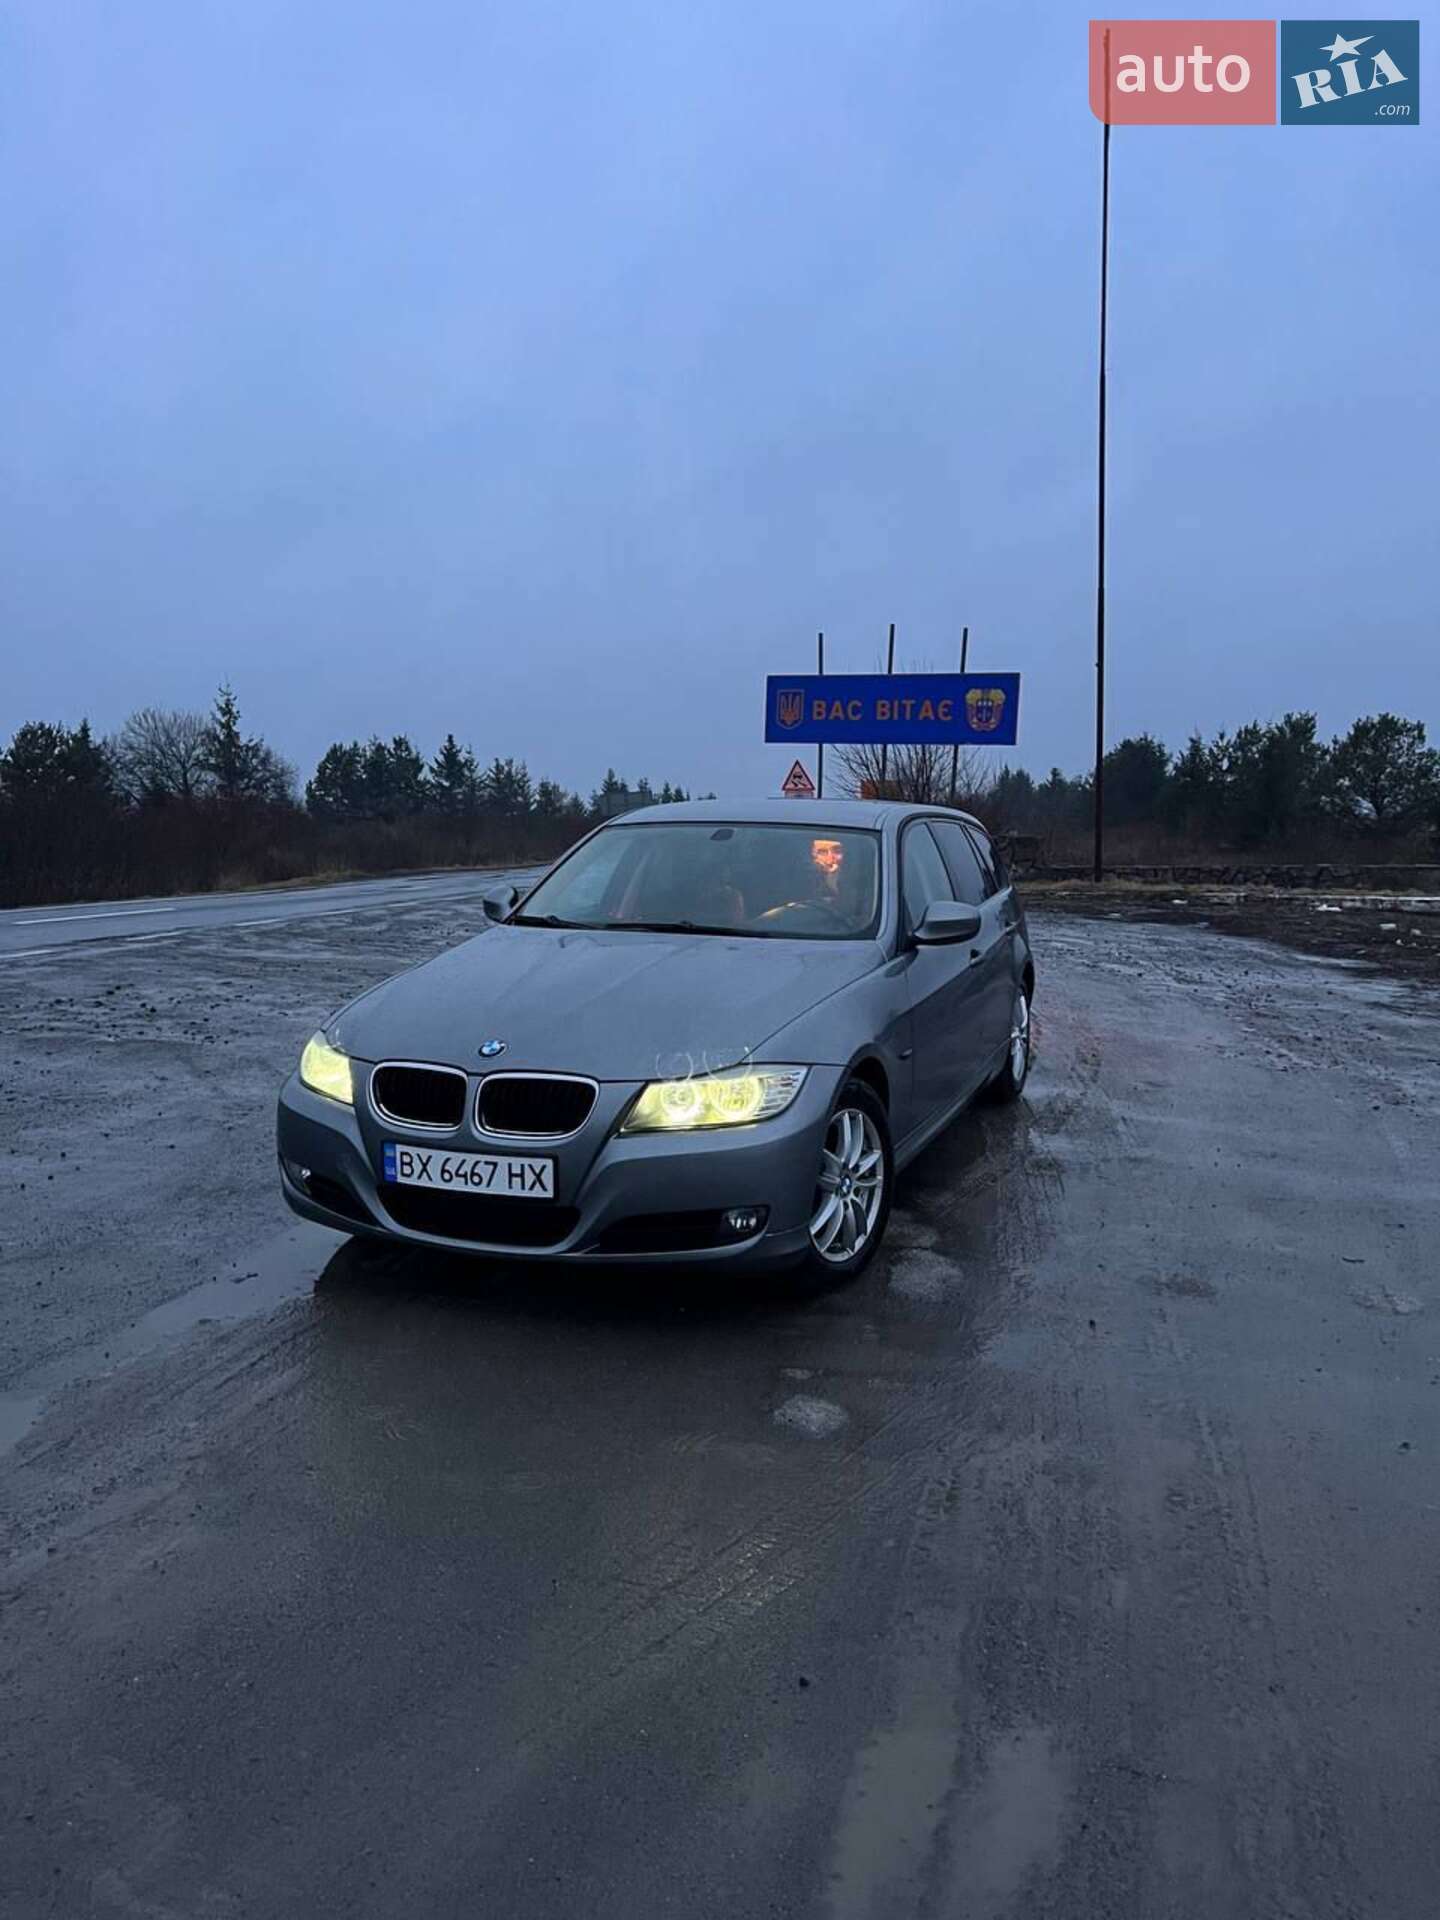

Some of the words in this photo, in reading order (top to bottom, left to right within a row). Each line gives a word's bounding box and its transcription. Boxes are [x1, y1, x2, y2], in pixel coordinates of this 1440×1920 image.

[812, 700, 863, 721] ВАС
[876, 700, 953, 721] ВІТАЄ
[400, 1151, 433, 1182] BX
[440, 1157, 499, 1188] 6467
[507, 1162, 548, 1192] HX
